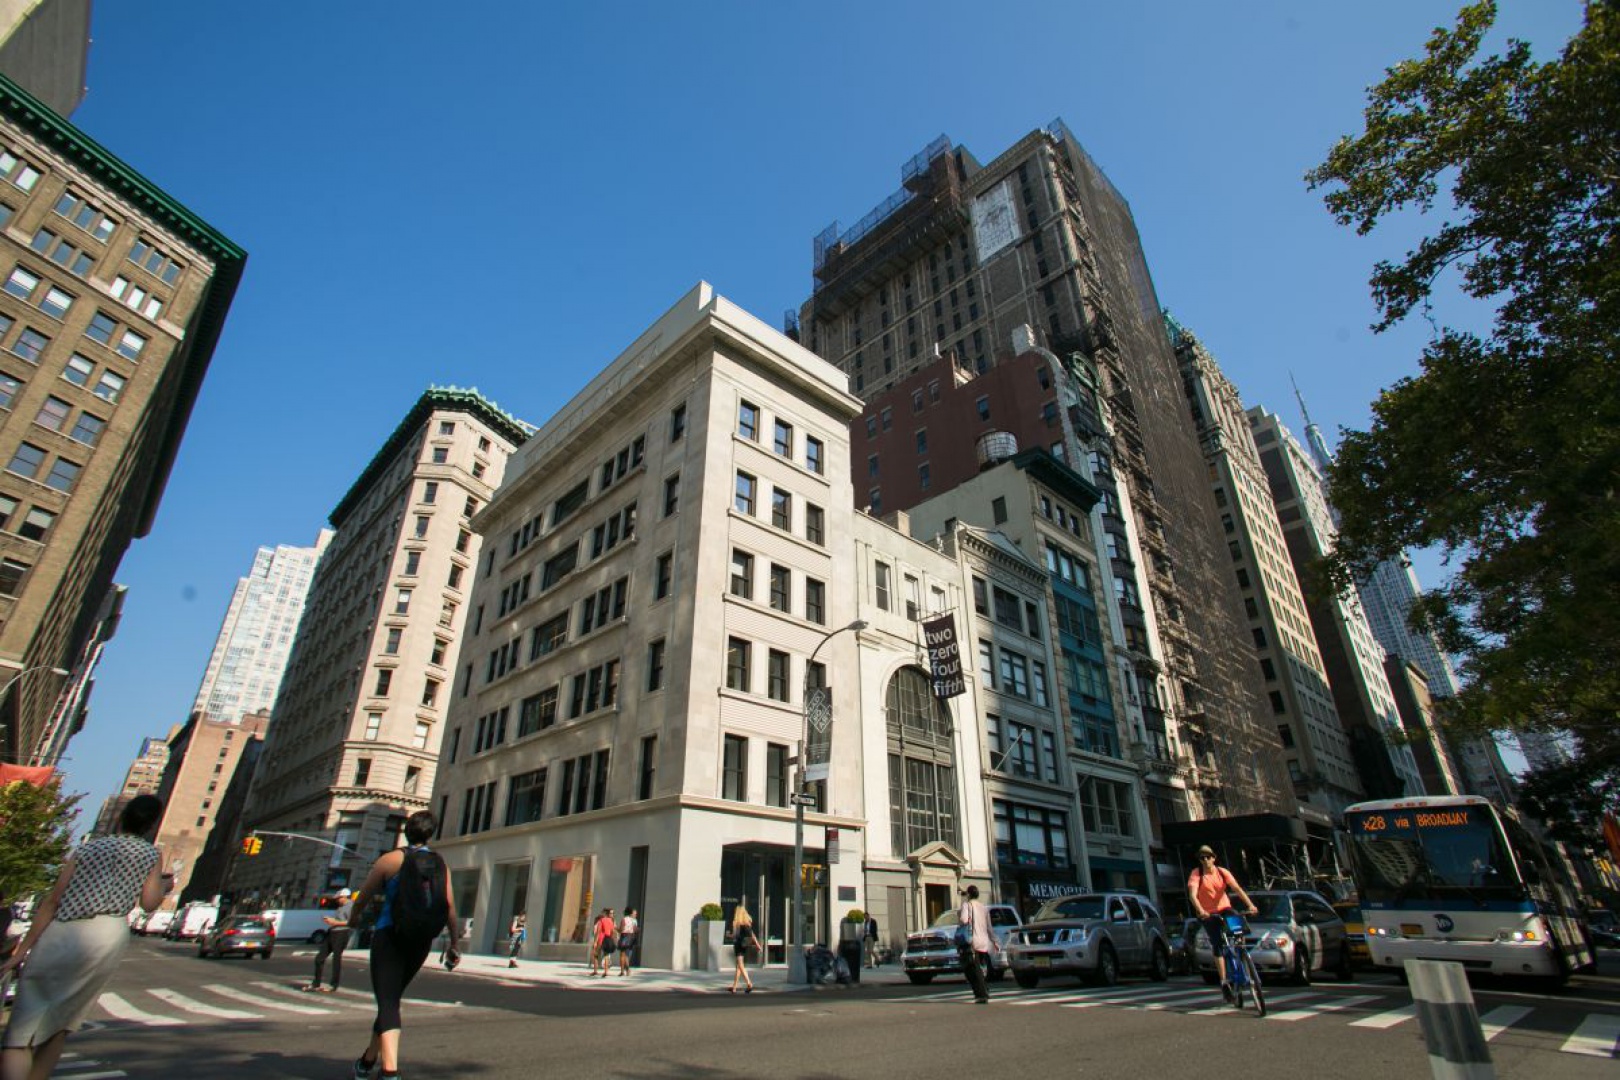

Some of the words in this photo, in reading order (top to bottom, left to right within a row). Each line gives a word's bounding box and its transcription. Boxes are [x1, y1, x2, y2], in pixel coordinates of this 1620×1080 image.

[926, 628, 952, 644] two
[929, 643, 958, 660] zero
[932, 660, 959, 676] four
[934, 678, 963, 695] fifth
[1395, 818, 1410, 829] via
[1416, 812, 1468, 827] BROADWAY
